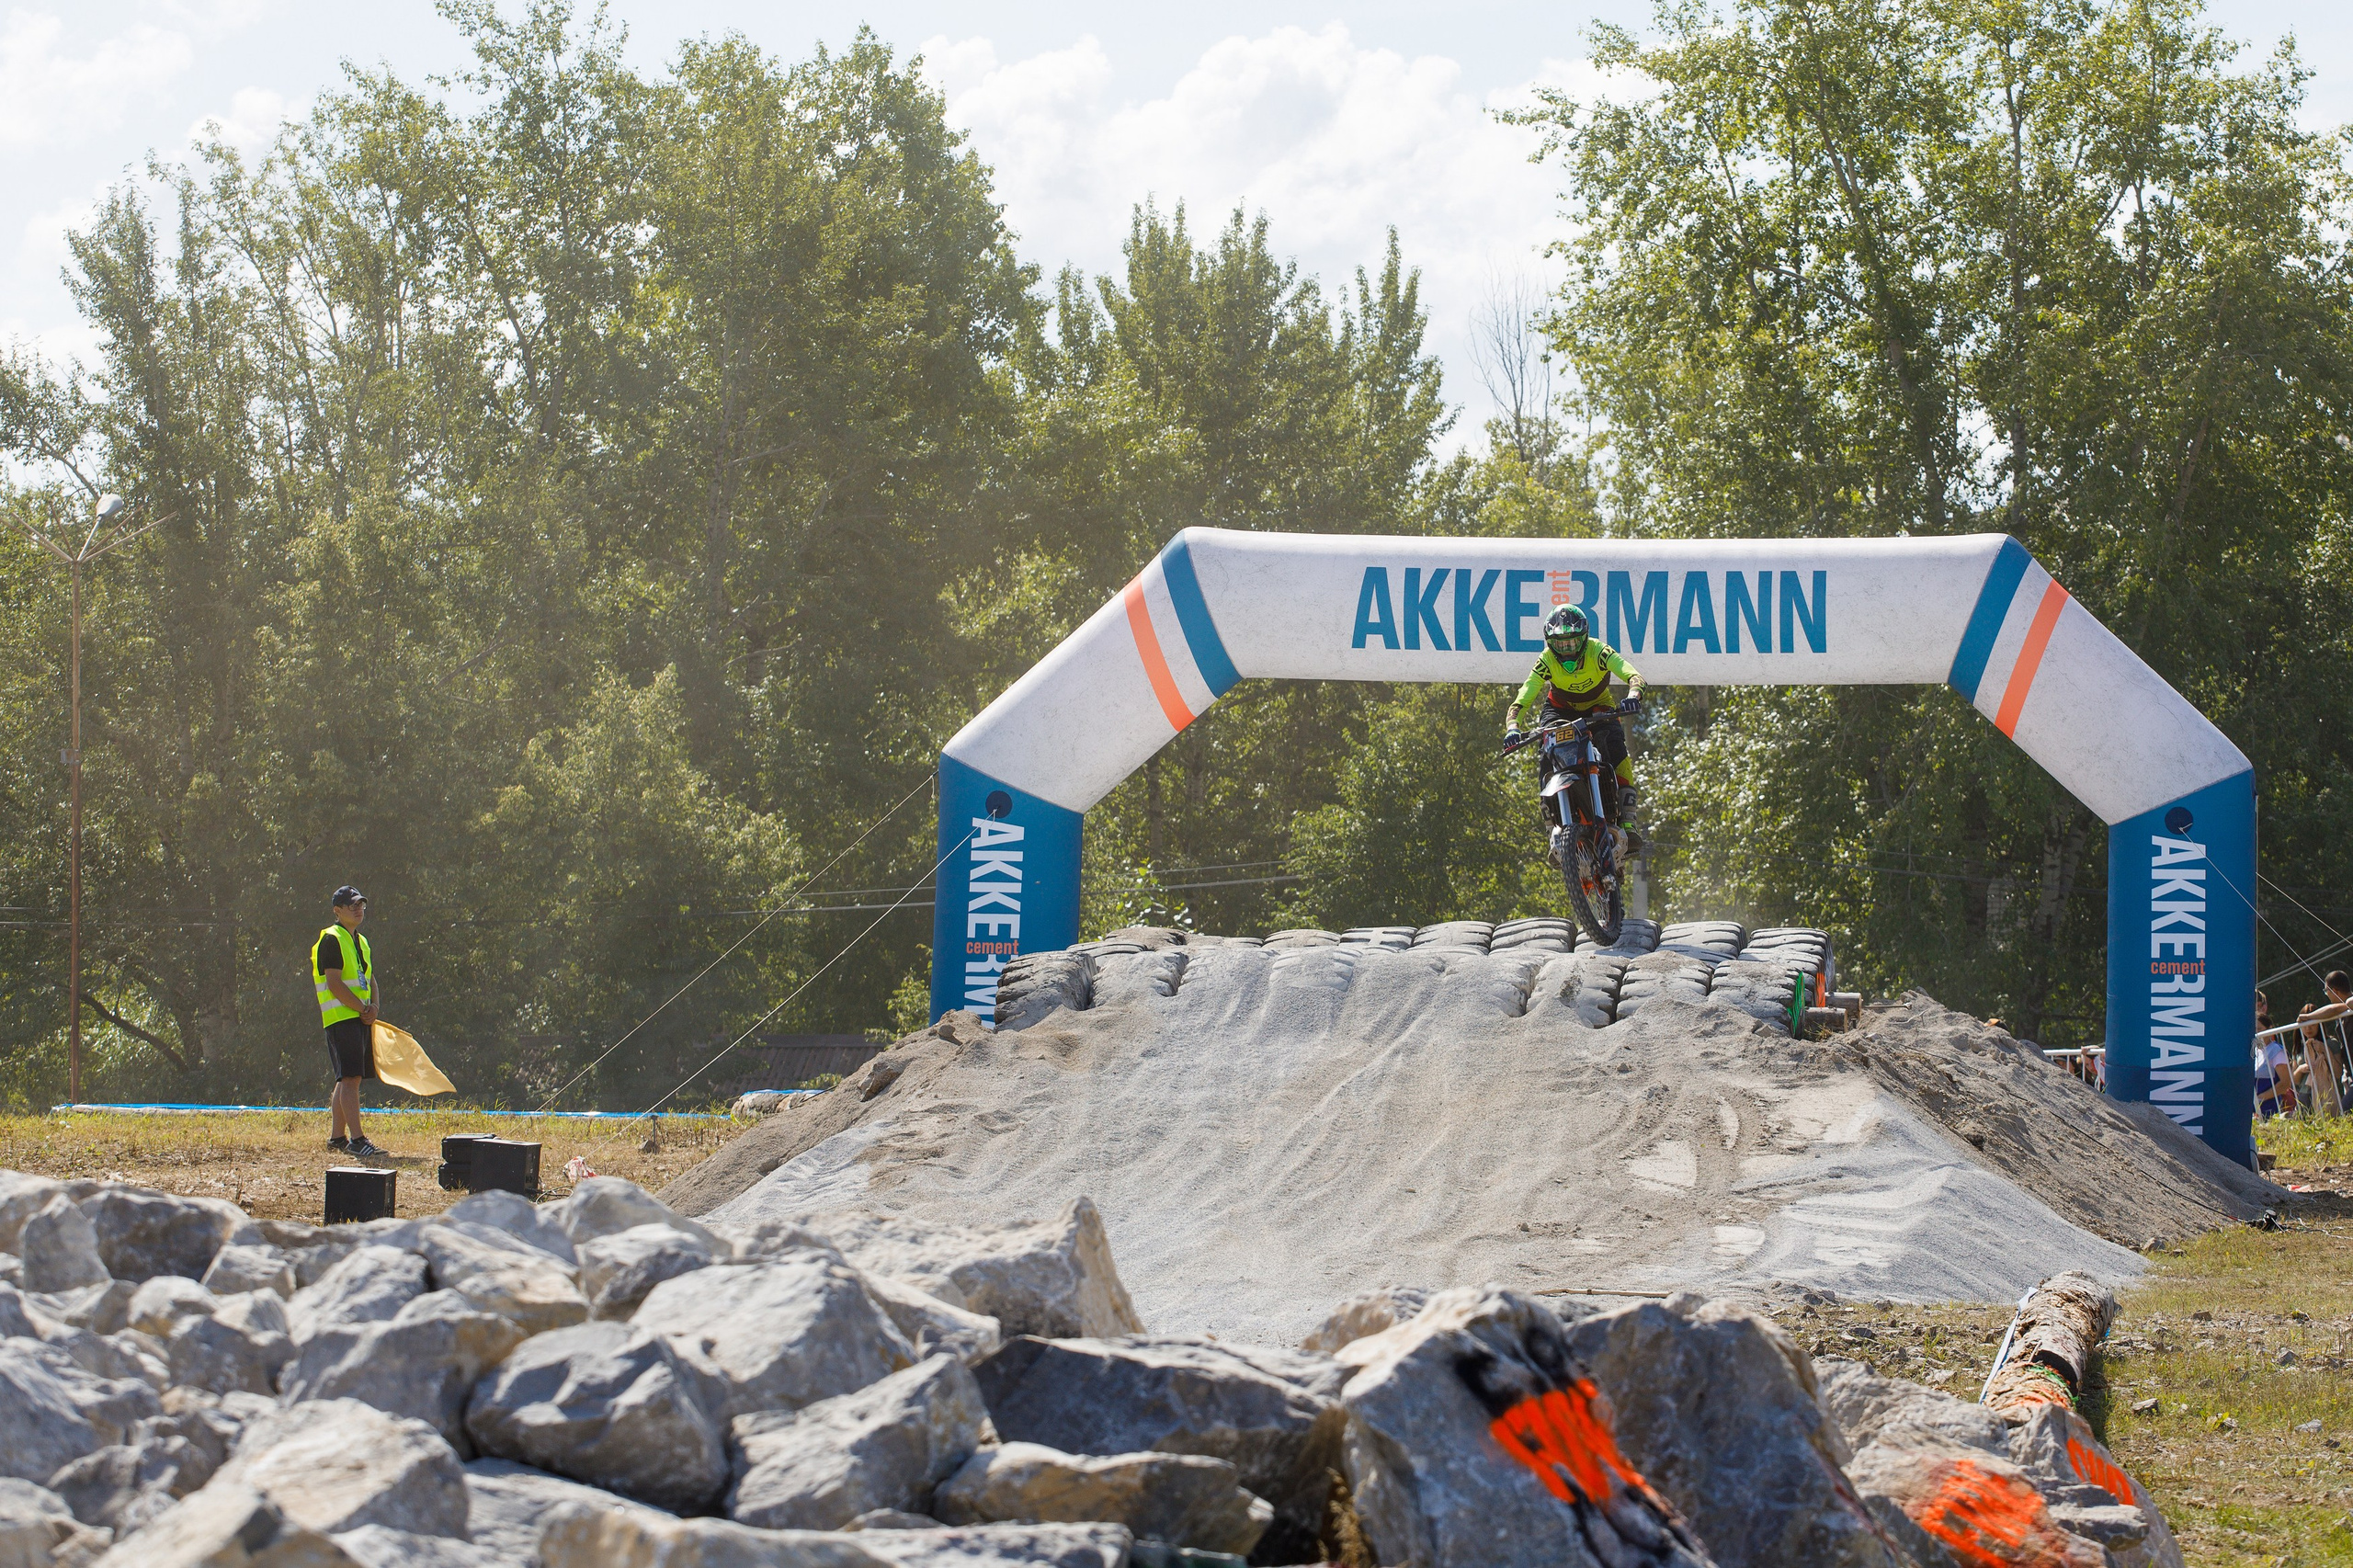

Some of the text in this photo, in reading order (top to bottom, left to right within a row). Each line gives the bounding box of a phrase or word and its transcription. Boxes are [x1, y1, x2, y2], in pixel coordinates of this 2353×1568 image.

[1546, 570, 1571, 606] ent
[1351, 566, 1827, 654] AKKERMANN
[963, 817, 1025, 1029] AKKERM
[966, 938, 1019, 955] cement
[2150, 959, 2206, 975] cement
